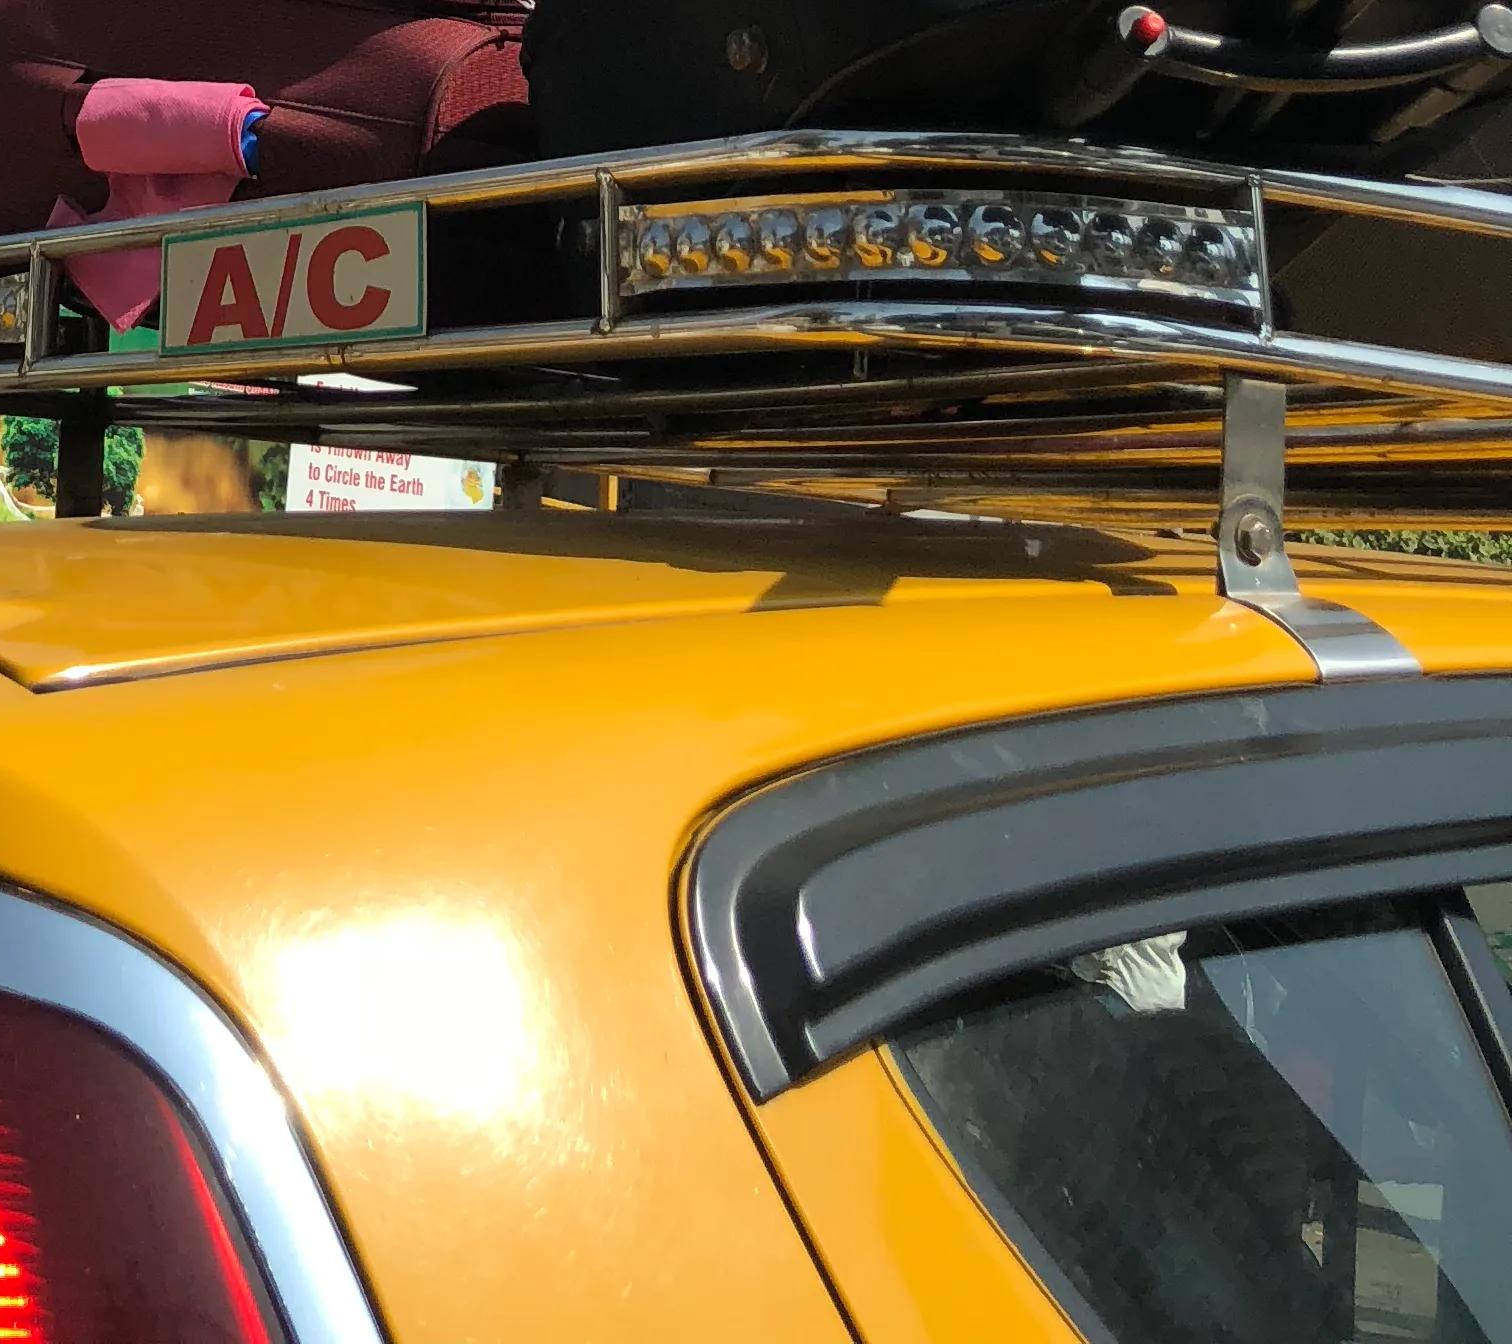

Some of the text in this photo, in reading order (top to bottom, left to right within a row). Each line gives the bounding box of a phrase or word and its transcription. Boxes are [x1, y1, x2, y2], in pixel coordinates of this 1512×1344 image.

[187, 226, 391, 345] A/C
[308, 462, 425, 496] to Circle the Earth
[305, 489, 357, 512] 4 Times
